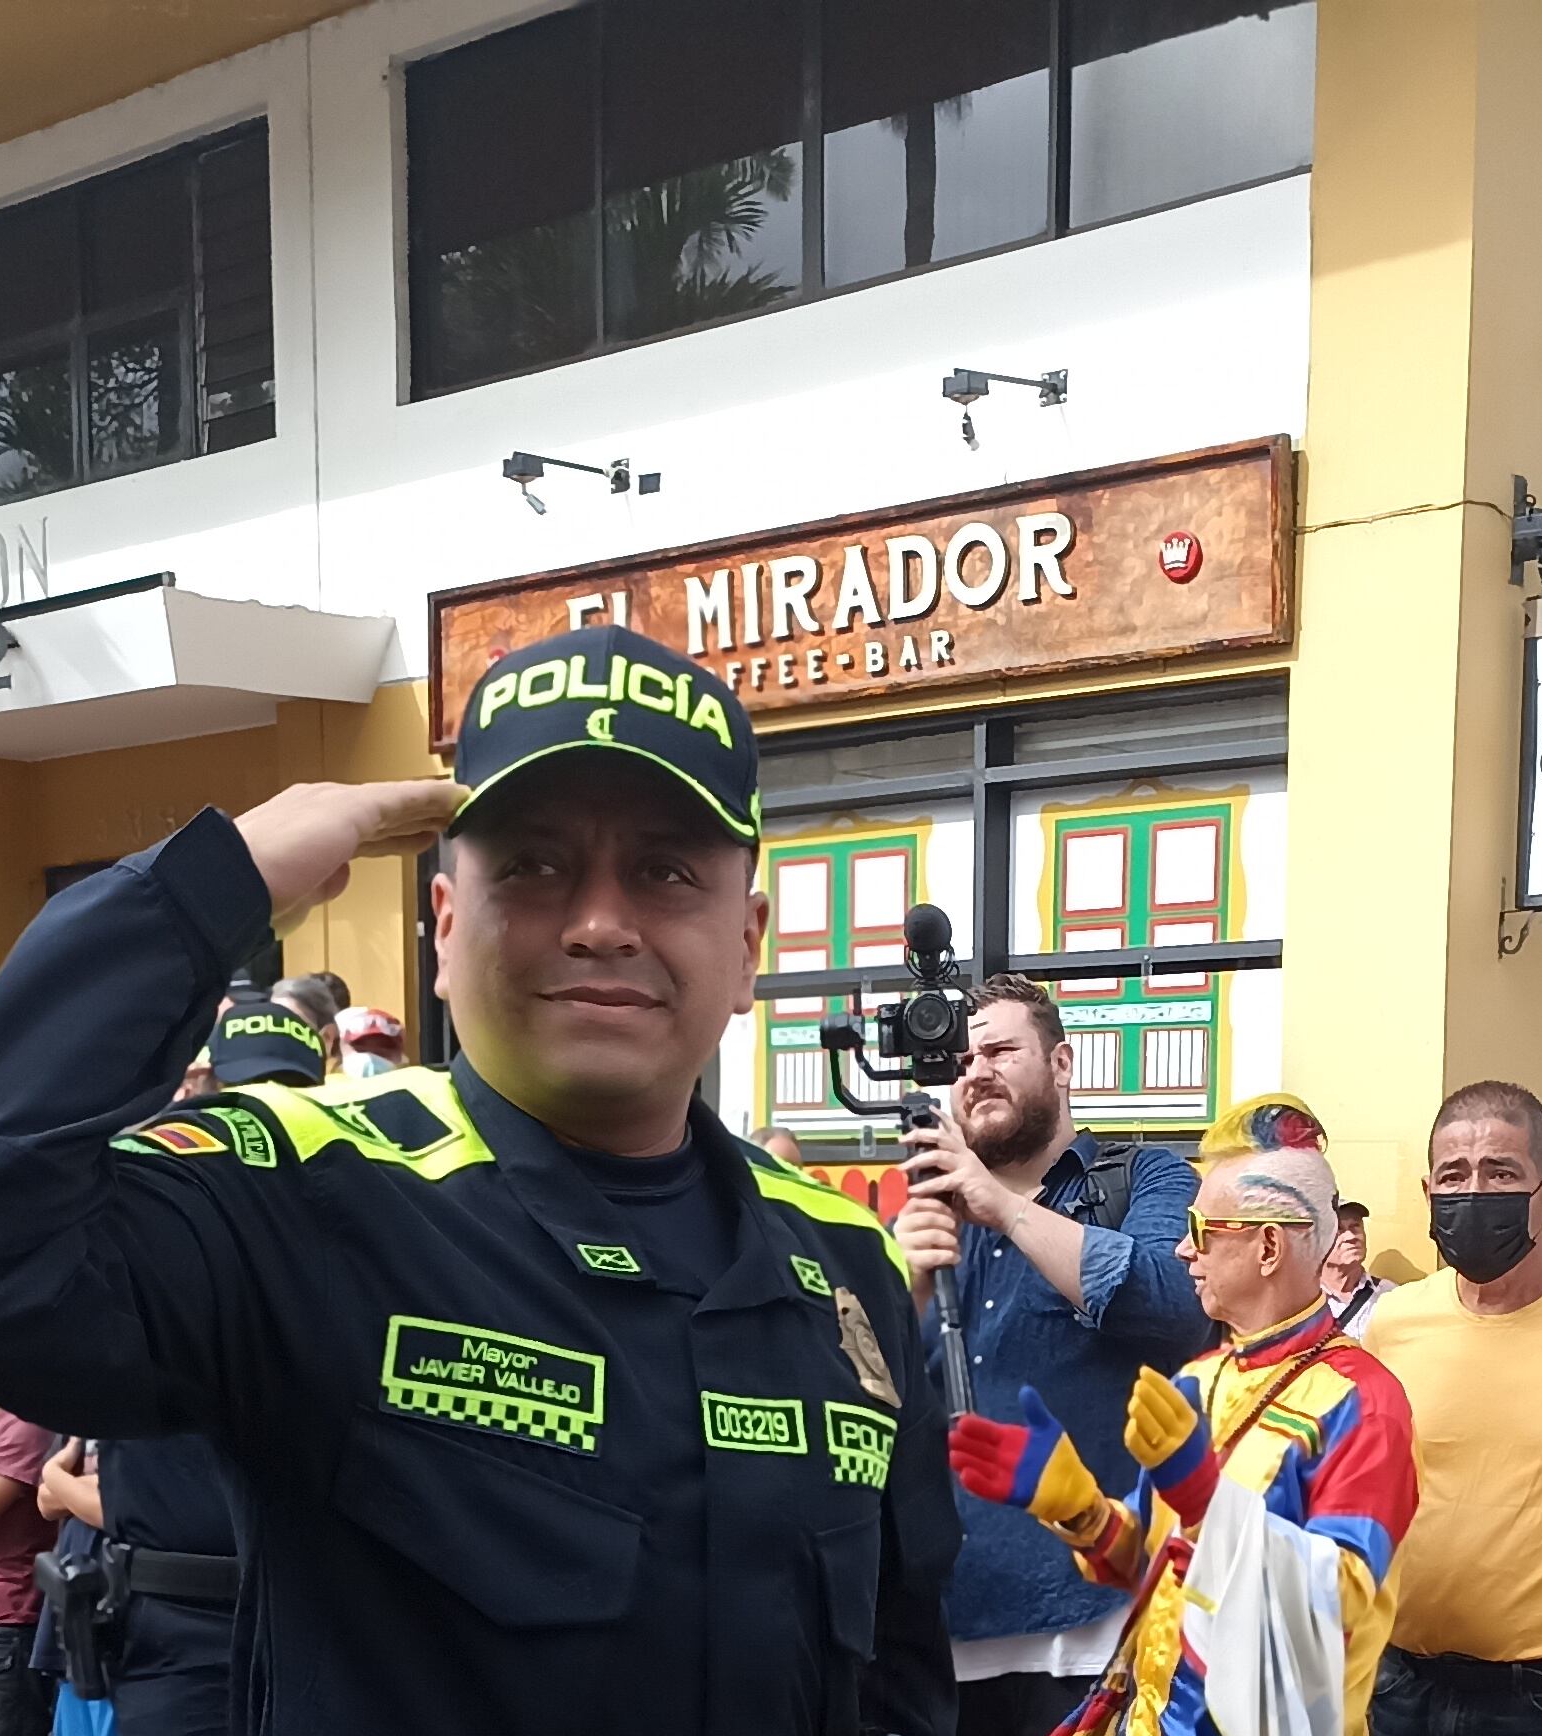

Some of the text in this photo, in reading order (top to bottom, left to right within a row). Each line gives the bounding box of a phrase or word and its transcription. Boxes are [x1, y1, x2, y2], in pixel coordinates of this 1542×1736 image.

[684, 512, 1075, 655] MIRADOR
[479, 656, 733, 750] POLICÍA
[461, 1337, 539, 1370] Mayor
[409, 1356, 581, 1405] JAVIER VALLEJO
[715, 1404, 790, 1443] 003219
